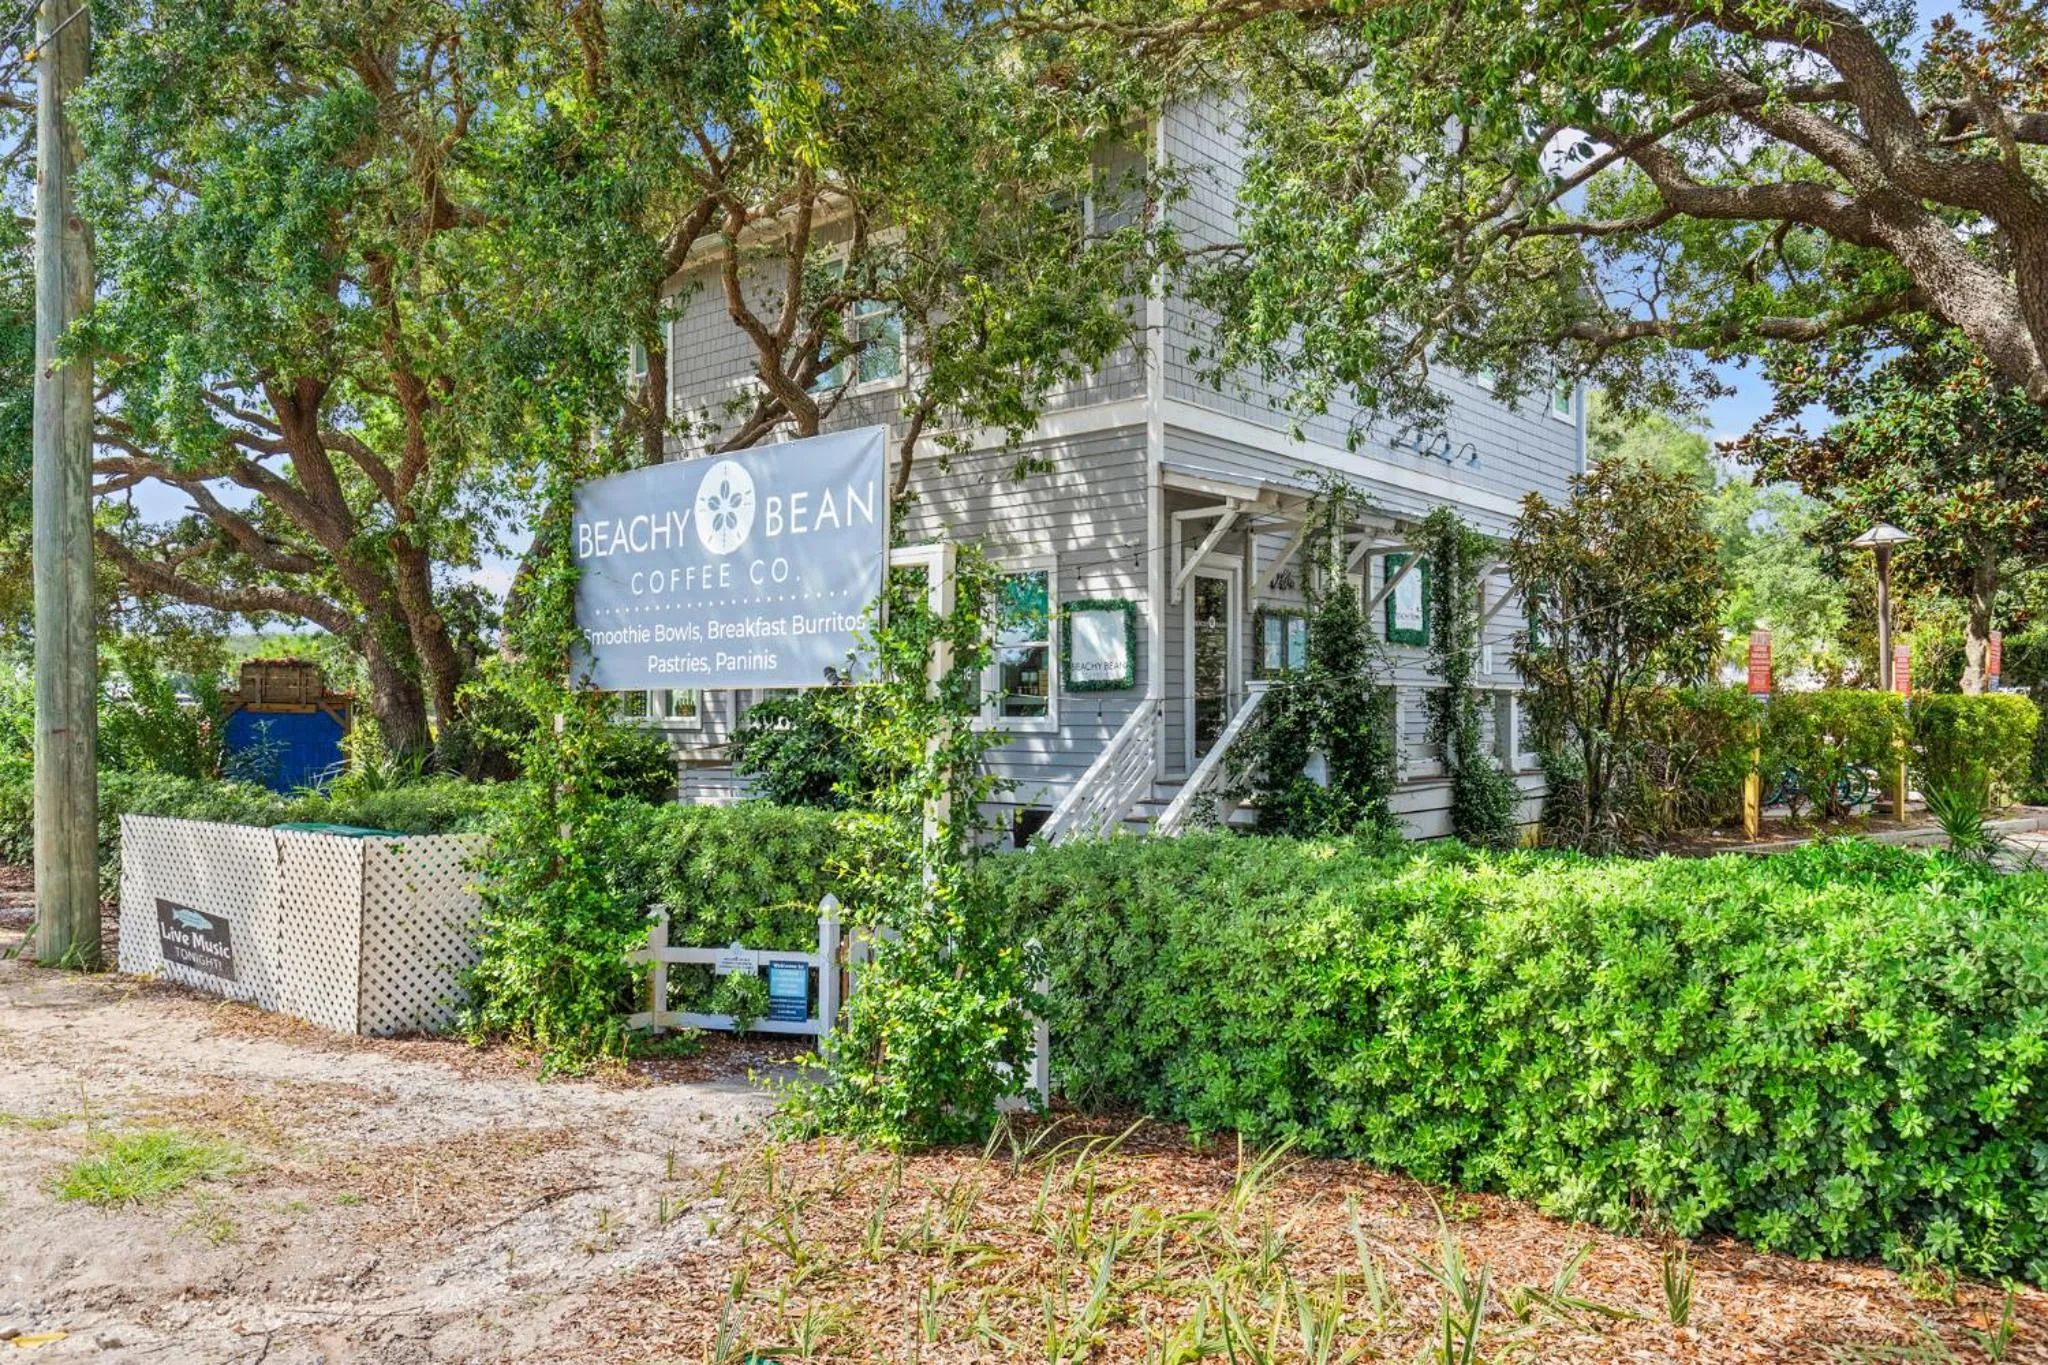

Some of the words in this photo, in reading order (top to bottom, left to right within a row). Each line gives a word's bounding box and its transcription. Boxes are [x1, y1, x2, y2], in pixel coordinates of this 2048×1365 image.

[579, 508, 690, 559] BEACHY
[765, 480, 874, 537] BEAN
[631, 562, 732, 596] COFFEE
[750, 557, 801, 586] CO.
[584, 624, 650, 646] Smoothie
[654, 621, 703, 643] Bowls,
[708, 616, 787, 639] Breakfast
[792, 611, 866, 635] Burritos
[648, 652, 711, 675] Pastries,
[716, 649, 777, 671] Paninis
[161, 921, 190, 946] Live
[192, 931, 231, 959] Music
